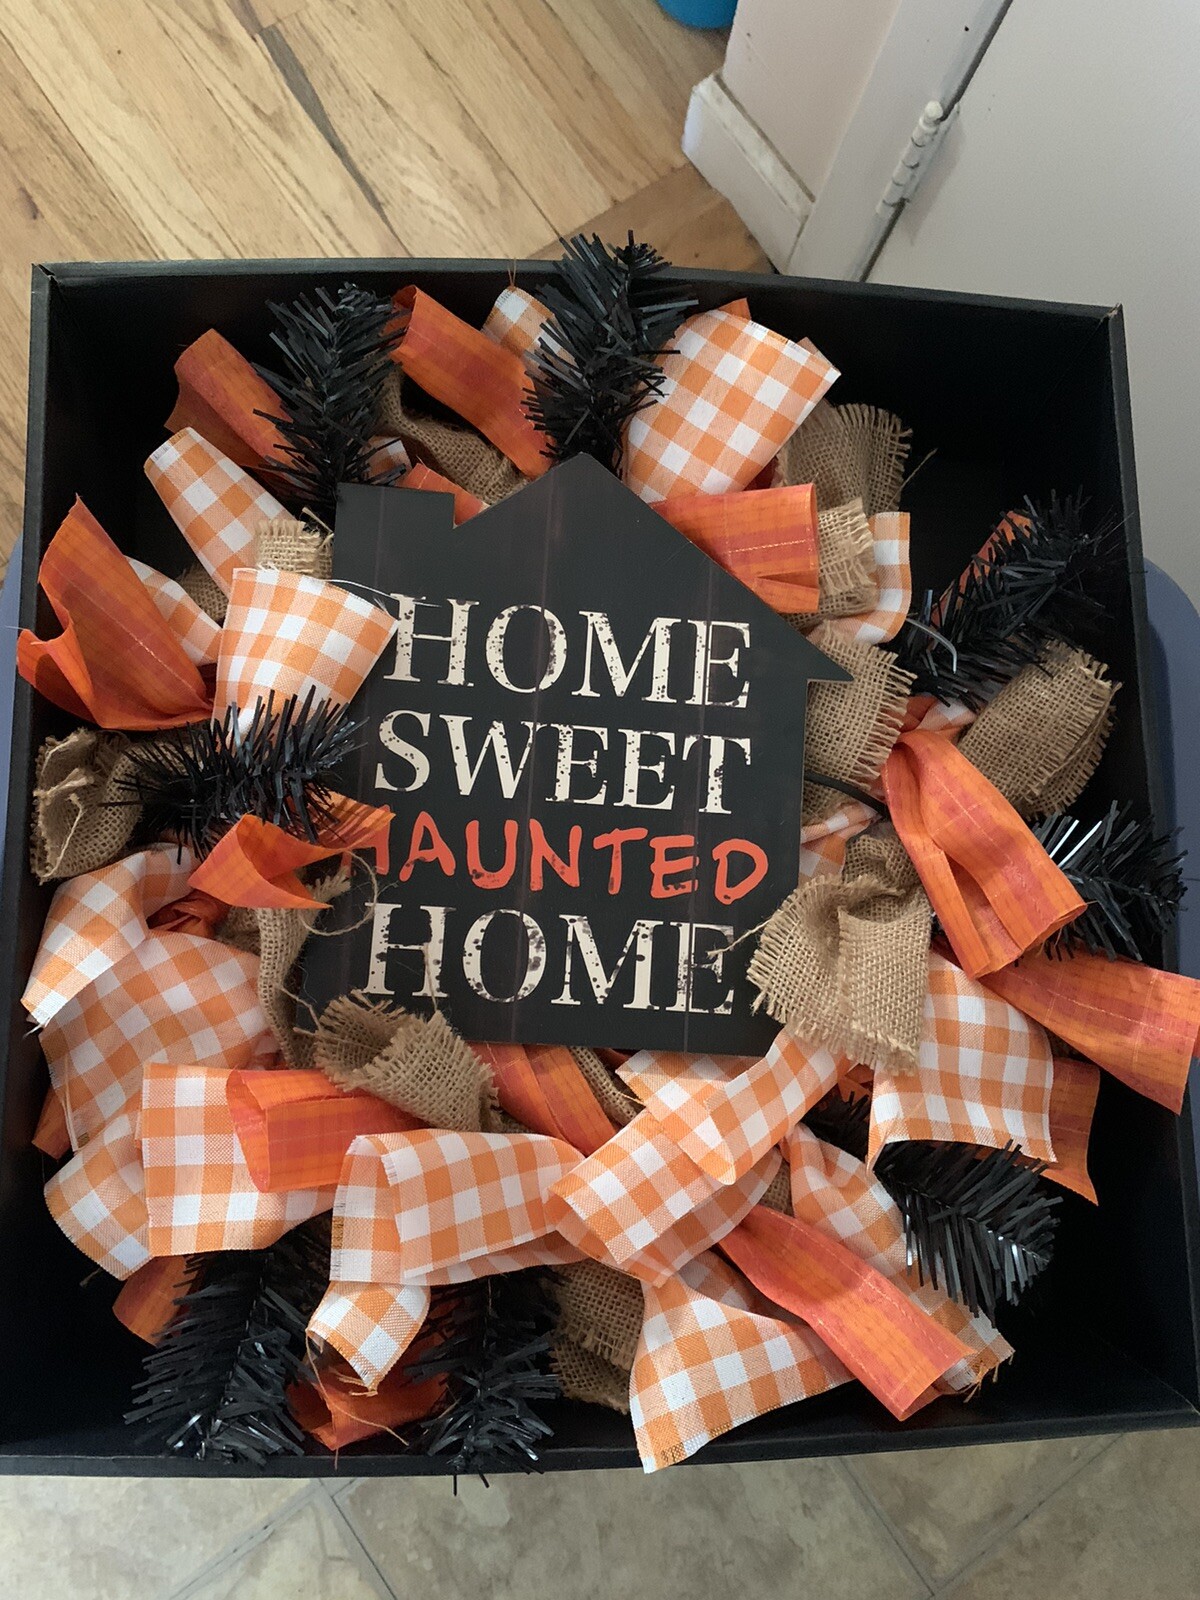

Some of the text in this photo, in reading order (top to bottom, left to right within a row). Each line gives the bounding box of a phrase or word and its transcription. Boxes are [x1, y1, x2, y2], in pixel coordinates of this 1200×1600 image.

[384, 593, 751, 708] HOME
[375, 709, 752, 814] SWEET
[364, 902, 735, 1015] HOME
